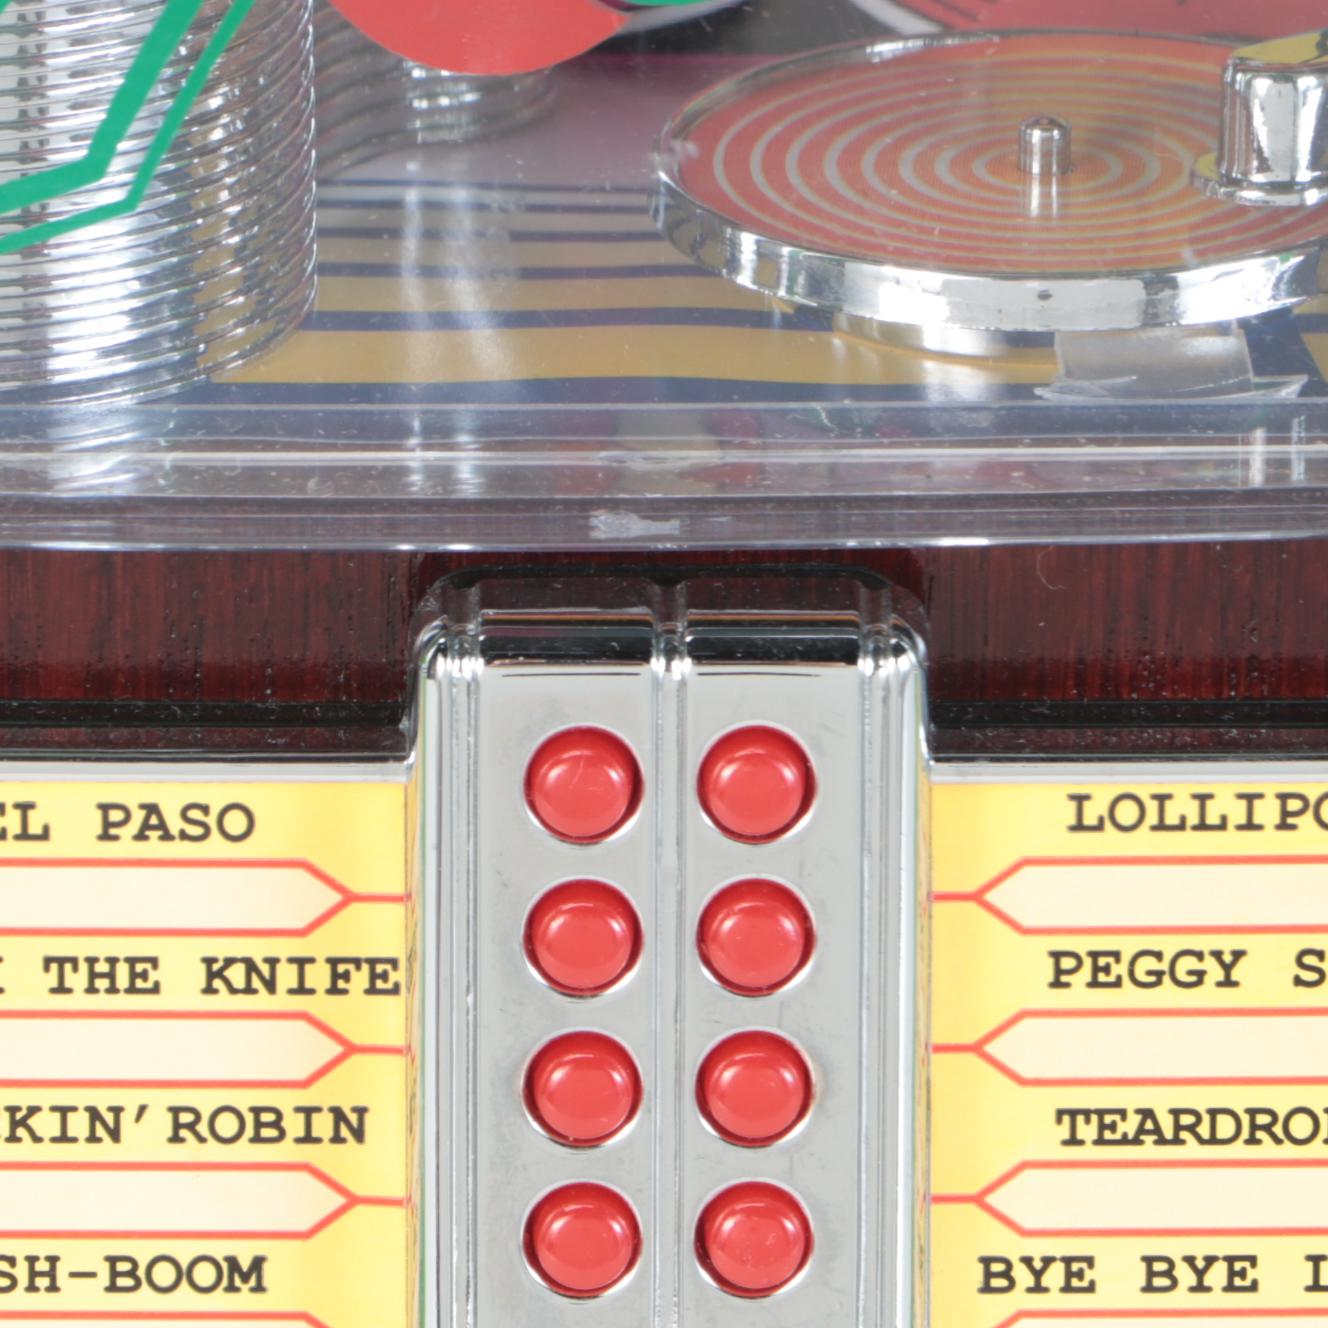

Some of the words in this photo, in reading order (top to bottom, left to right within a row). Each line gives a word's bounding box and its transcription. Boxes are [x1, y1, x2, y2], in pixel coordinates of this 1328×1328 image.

[98, 803, 254, 842] PASO
[44, 956, 160, 994] THE
[201, 957, 400, 995] KNIFE
[1049, 949, 1246, 988] PEGGY
[979, 1256, 1095, 1294] BYE
[1141, 1255, 1258, 1293] BYE
